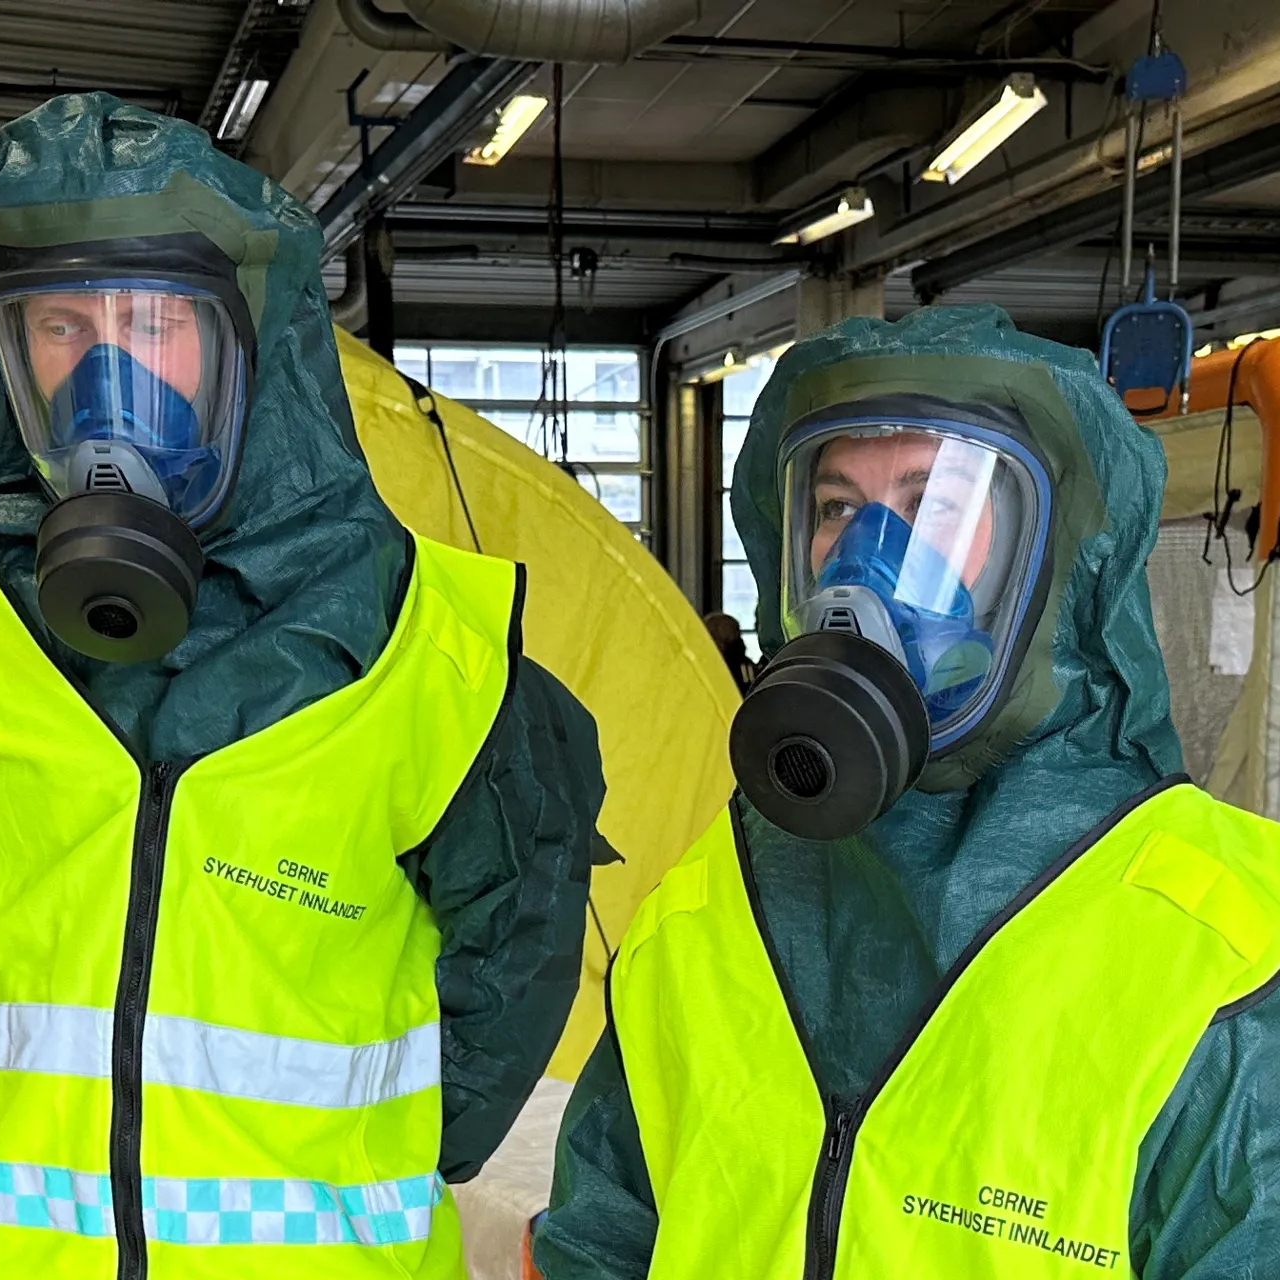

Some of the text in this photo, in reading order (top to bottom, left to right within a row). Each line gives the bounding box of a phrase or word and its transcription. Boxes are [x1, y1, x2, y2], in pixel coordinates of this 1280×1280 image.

[203, 856, 367, 921] SYKEHUSET INNLANDET
[277, 858, 330, 889] CBRNE
[978, 1185, 1048, 1220] CBRNE
[902, 1194, 1121, 1270] SYKEHUSET INNLANDET
